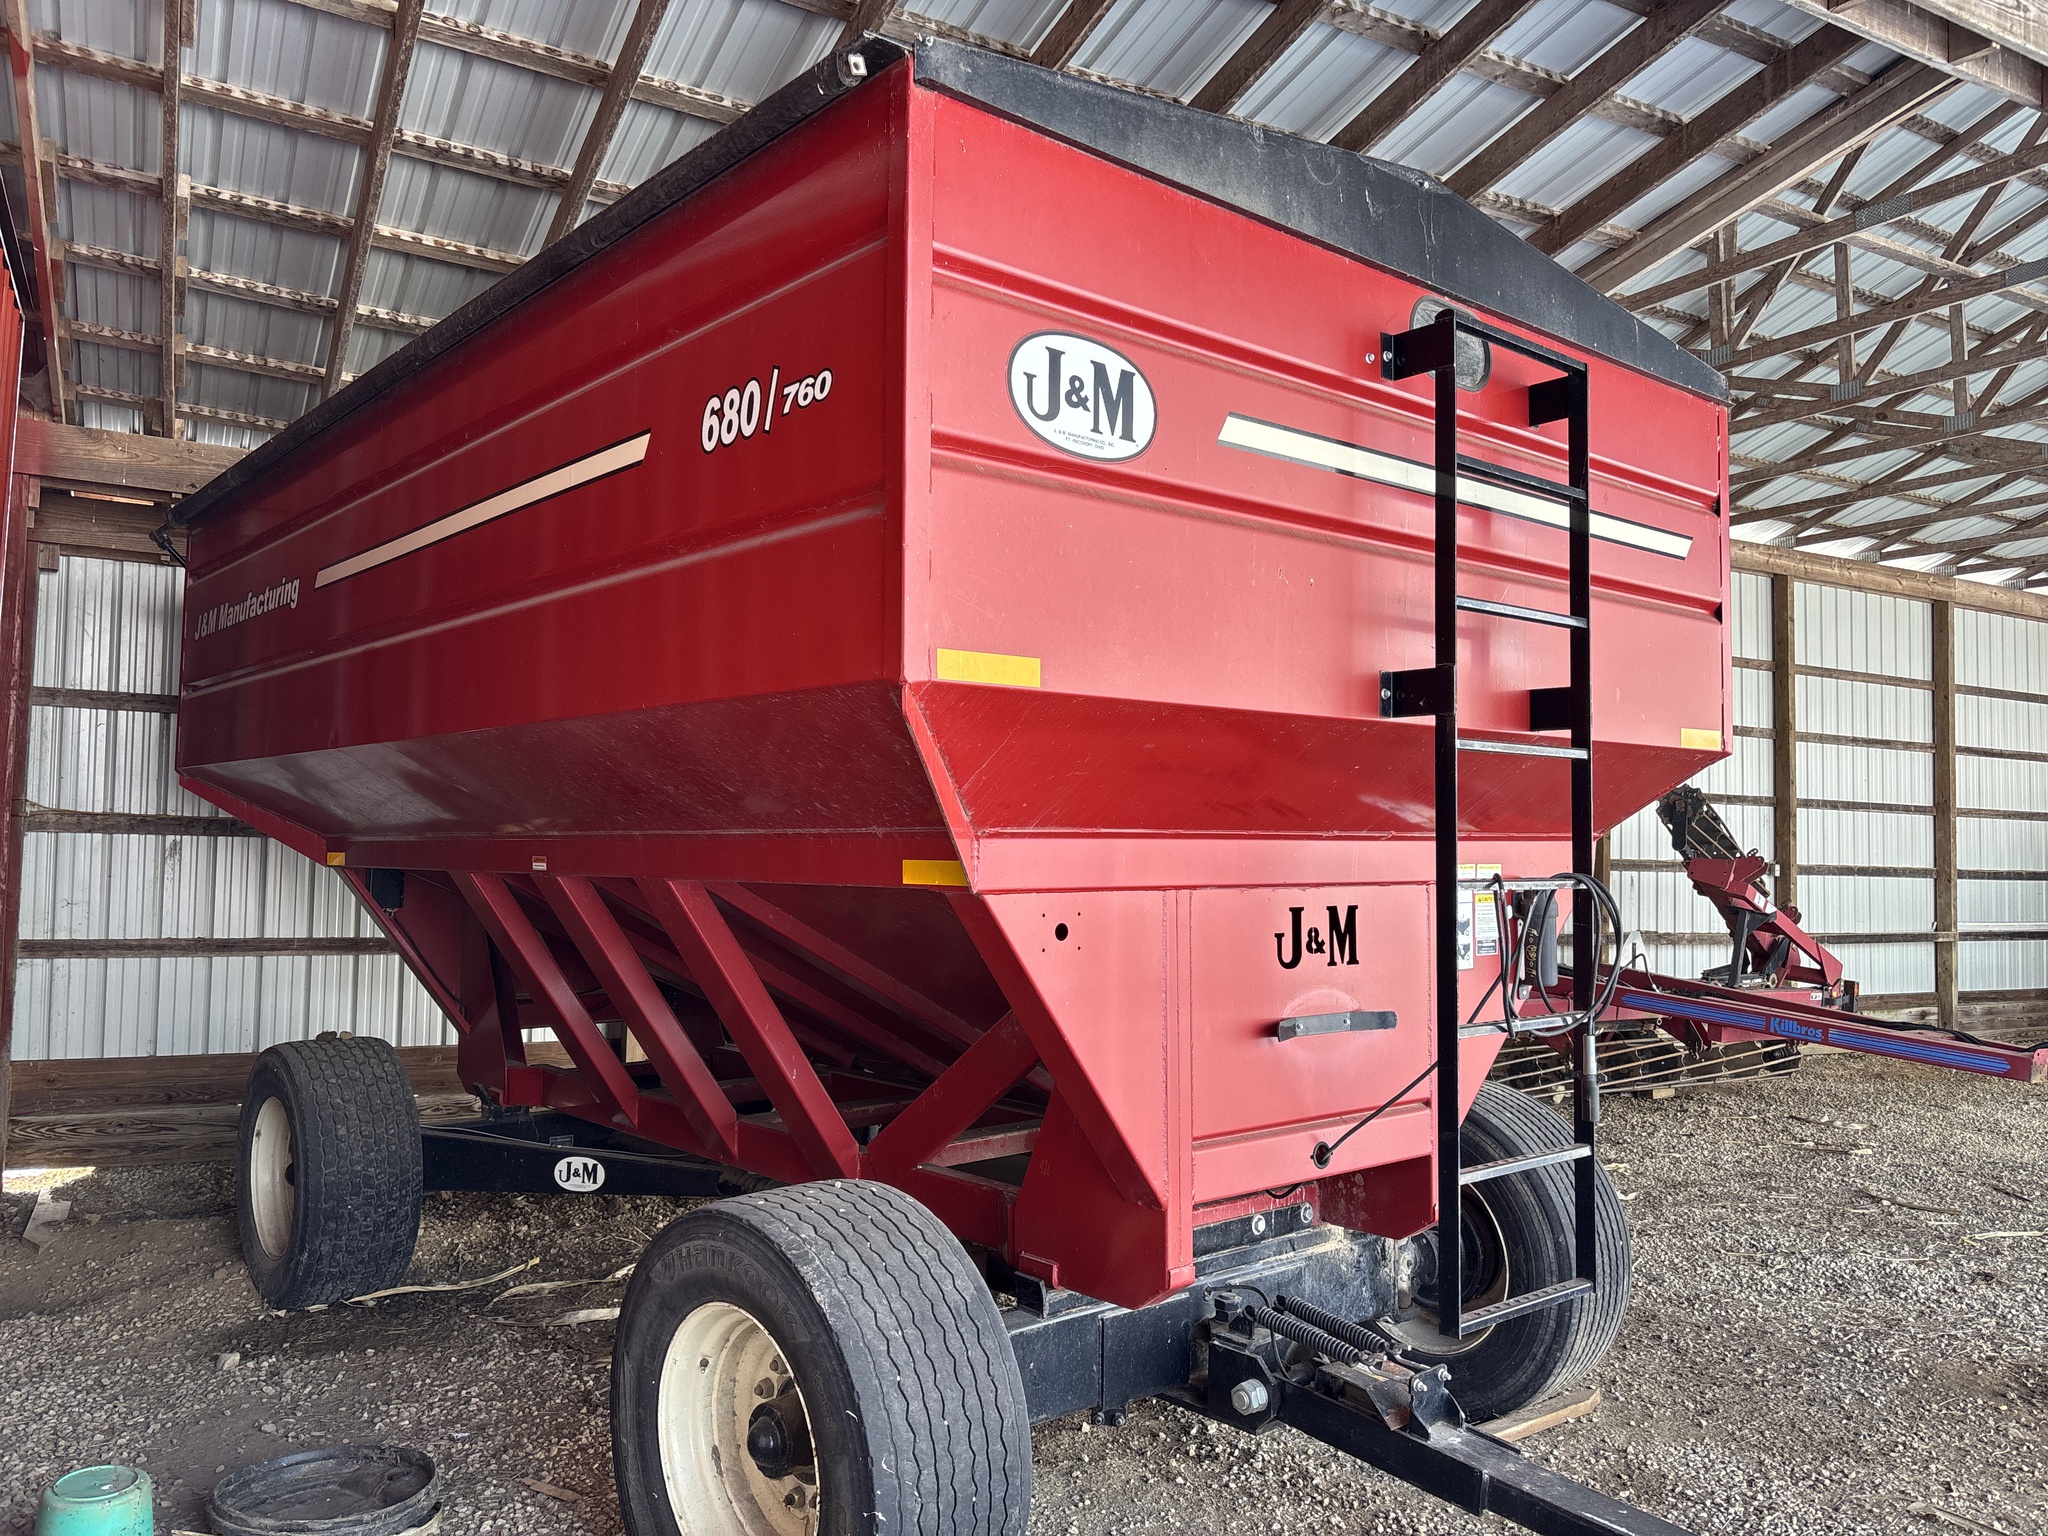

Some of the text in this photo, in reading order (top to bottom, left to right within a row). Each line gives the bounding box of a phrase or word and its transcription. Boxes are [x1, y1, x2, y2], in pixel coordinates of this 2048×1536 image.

[701, 366, 833, 454] 680/760
[1023, 345, 1136, 443] J&M
[1067, 431, 1099, 444] MANUFACTURING
[194, 577, 300, 640] J&M Manufacturing
[1274, 905, 1360, 970] J&M
[1769, 1016, 1823, 1041] Killbros
[558, 1161, 599, 1185] J&M
[677, 1243, 798, 1329] Hankook
